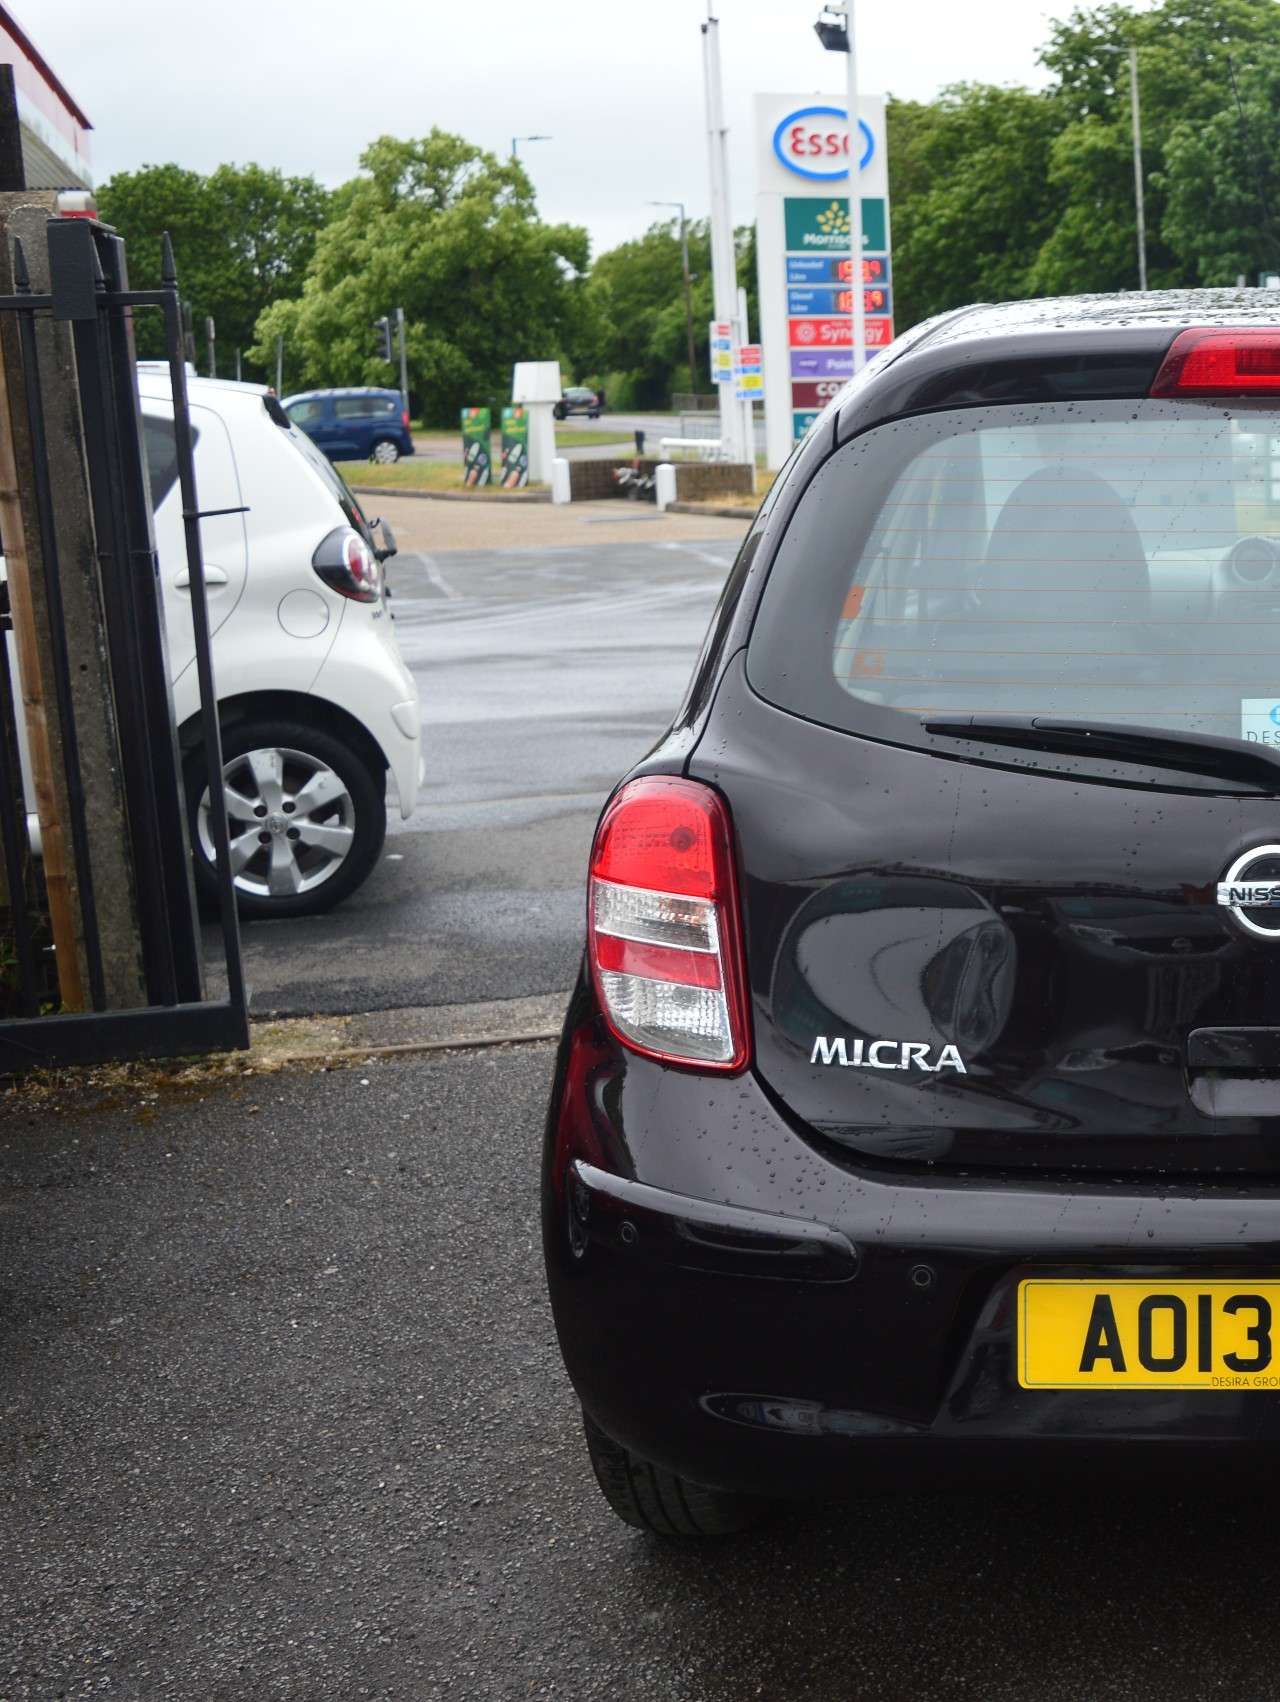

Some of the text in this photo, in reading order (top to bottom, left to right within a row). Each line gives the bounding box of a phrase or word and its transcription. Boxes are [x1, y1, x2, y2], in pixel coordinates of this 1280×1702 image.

[820, 324, 884, 343] Syngy
[810, 1036, 967, 1074] MICRA
[1078, 1293, 1272, 1373] AO13
[1211, 1376, 1249, 1387] DESIRA
